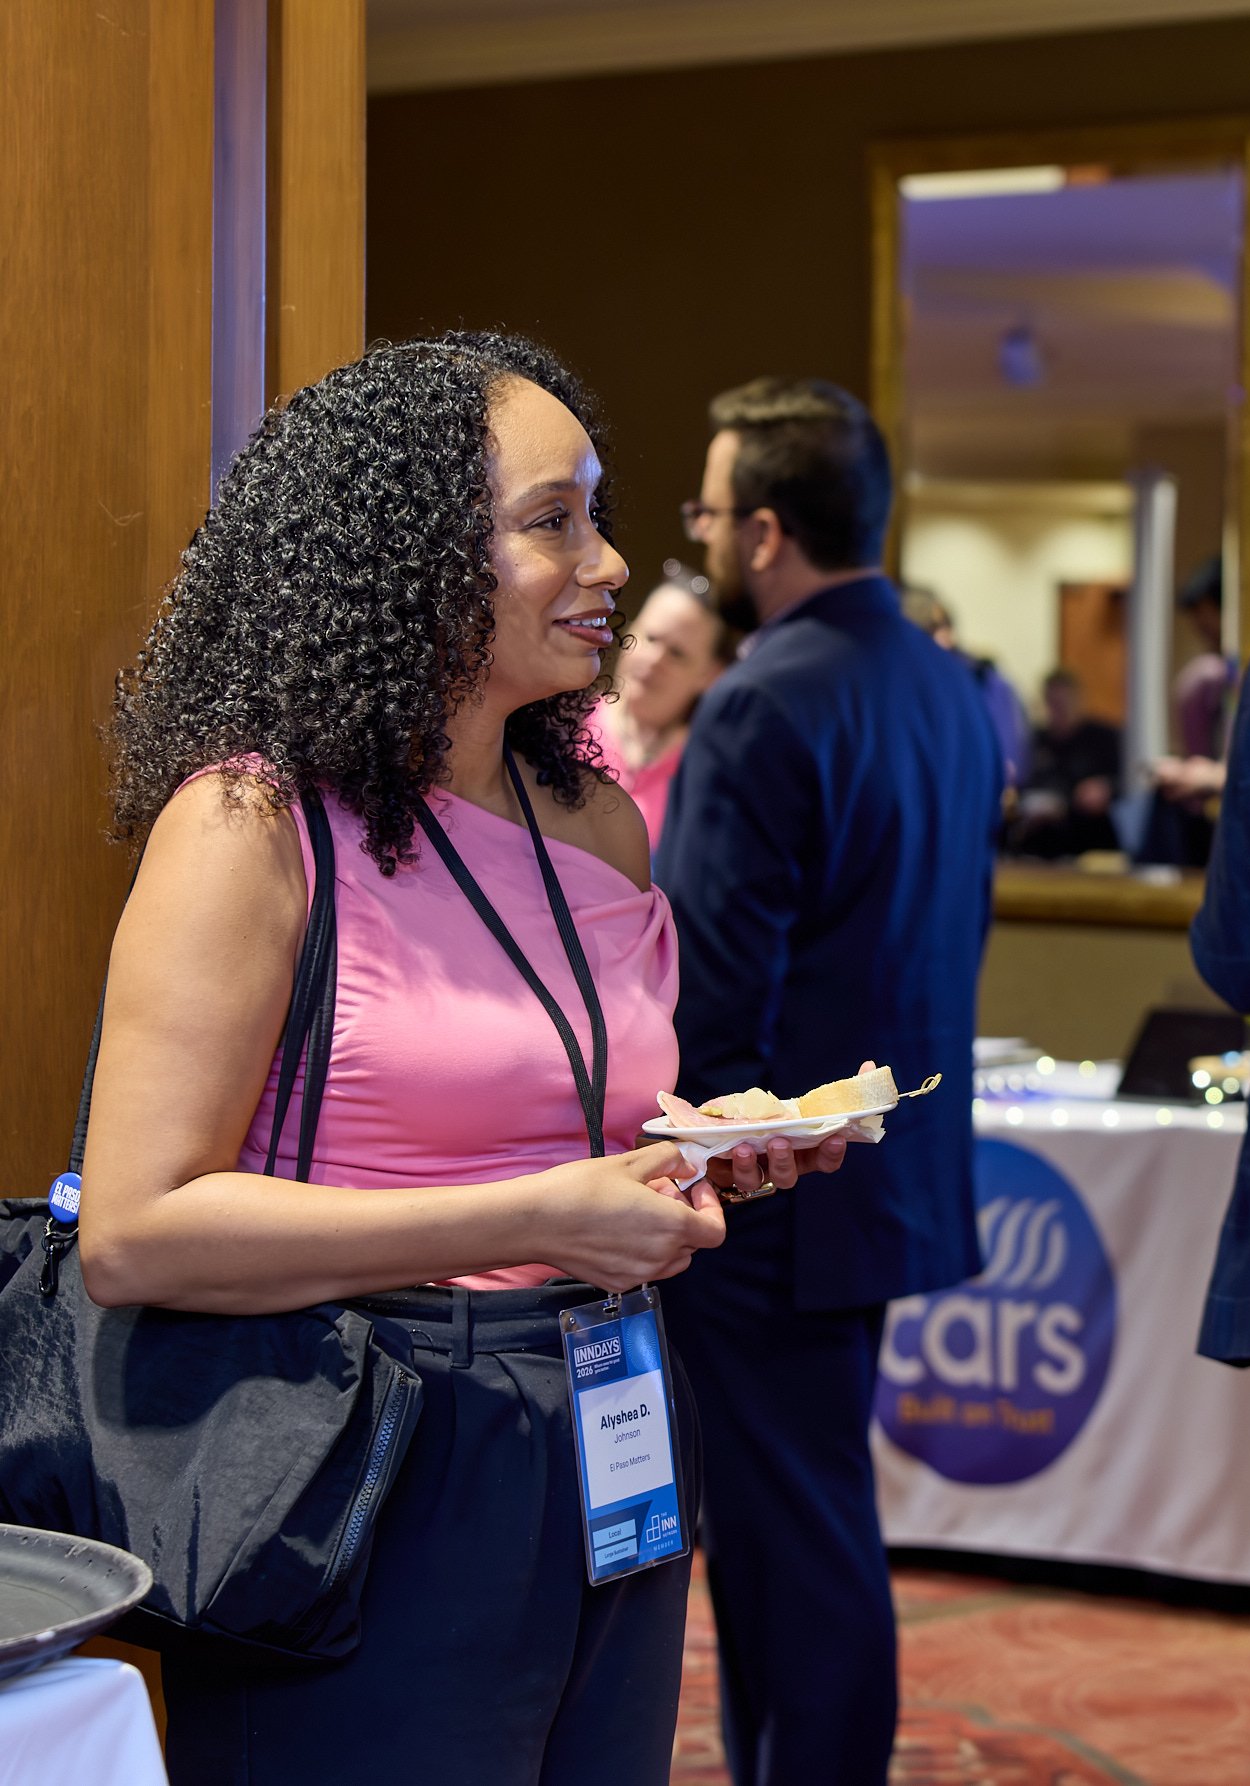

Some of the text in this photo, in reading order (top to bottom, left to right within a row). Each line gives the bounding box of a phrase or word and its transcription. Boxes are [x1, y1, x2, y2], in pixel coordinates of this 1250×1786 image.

[54, 1181, 63, 1194] EL
[576, 1338, 620, 1364] INNDAYS
[878, 1293, 1087, 1395] cars
[576, 1365, 594, 1379] 2026
[600, 1403, 651, 1430] Alyshea D.
[614, 1428, 641, 1444] Johnson
[609, 1453, 651, 1473] El Paso Matters
[661, 1515, 677, 1532] INN
[608, 1528, 622, 1539] Local
